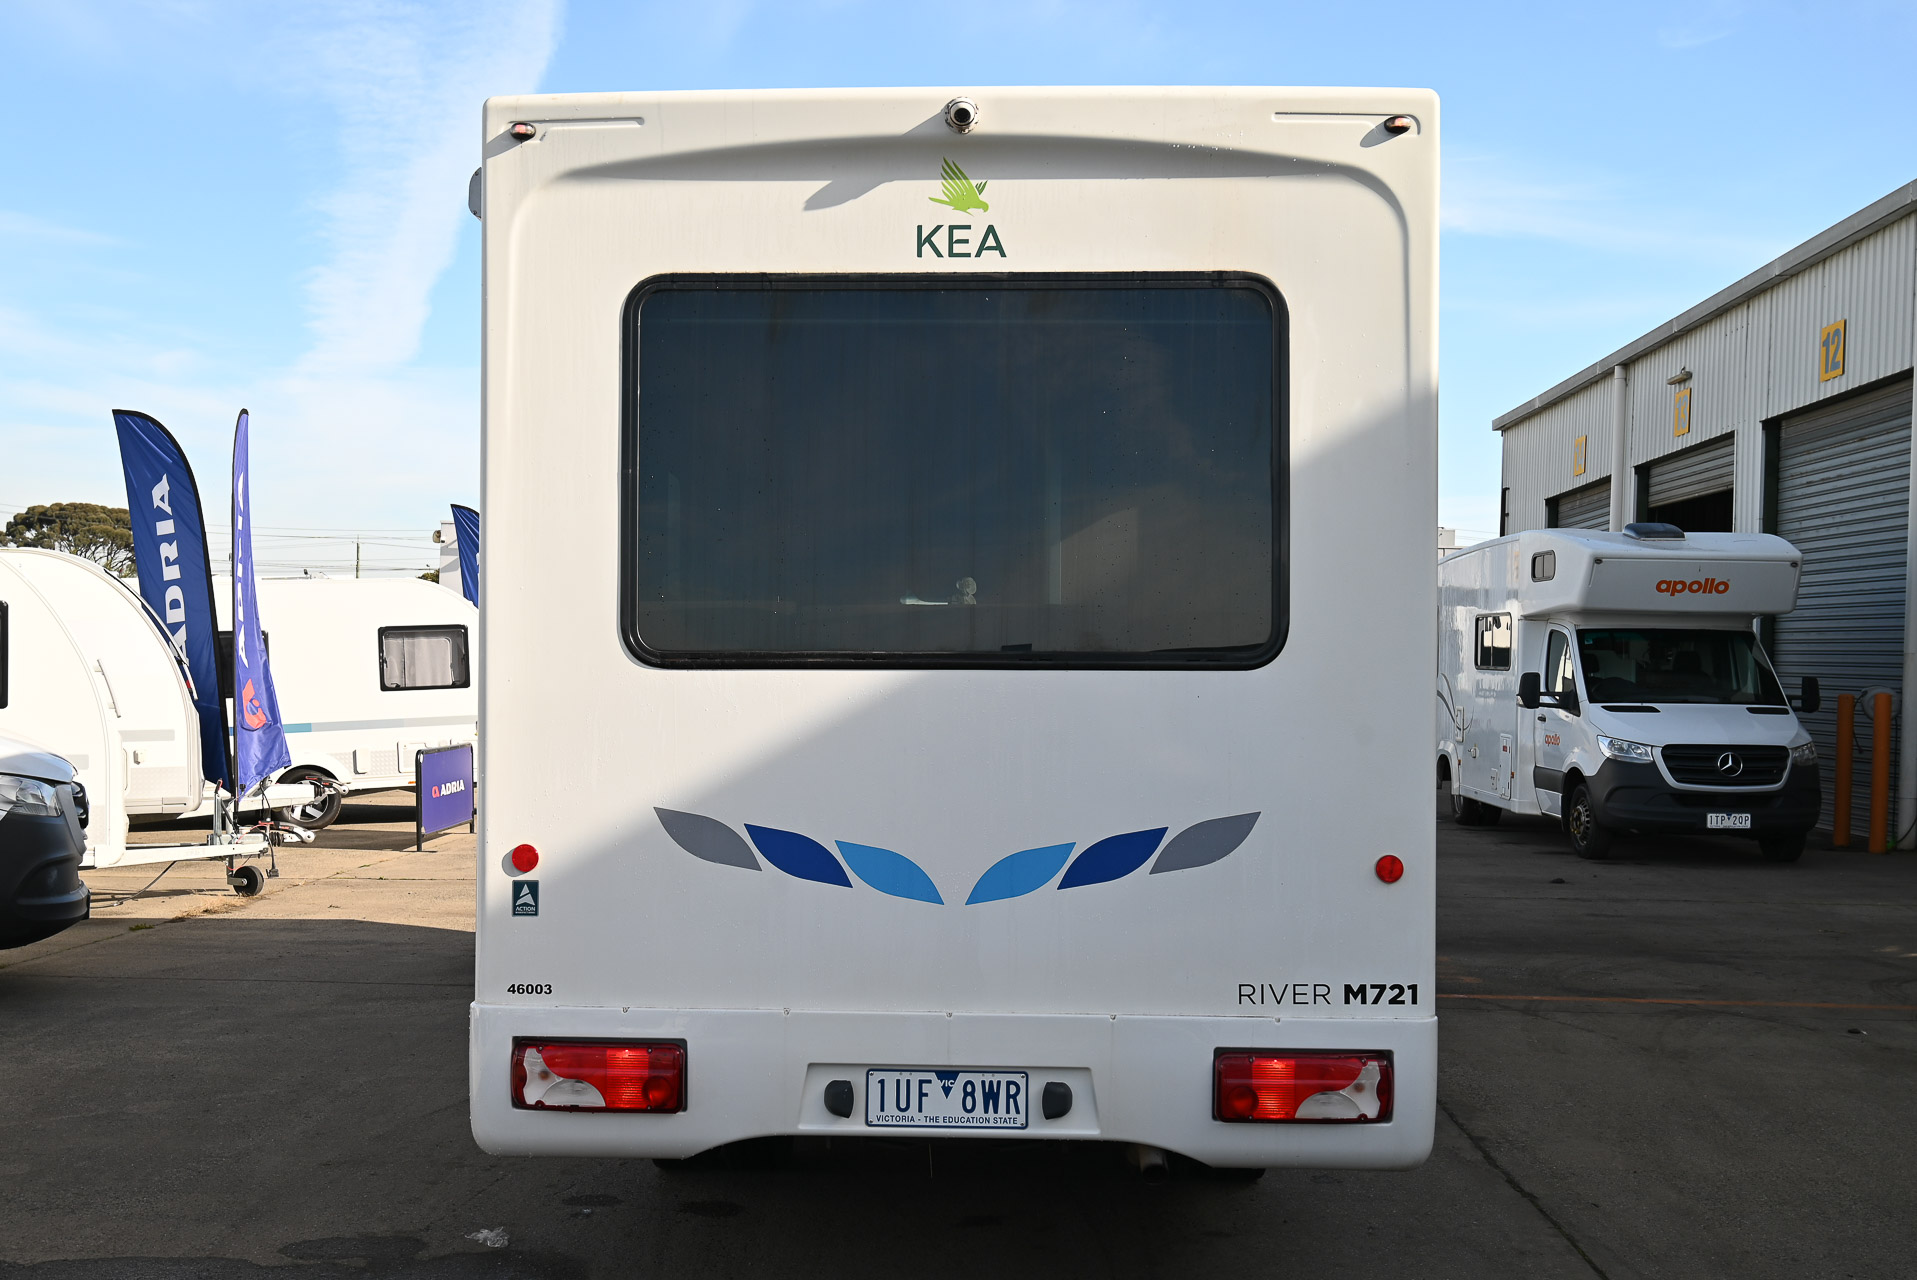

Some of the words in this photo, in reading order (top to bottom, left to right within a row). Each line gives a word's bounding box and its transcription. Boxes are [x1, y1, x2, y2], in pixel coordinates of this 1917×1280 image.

[917, 224, 1007, 258] KEA
[1822, 328, 1842, 374] 12
[1676, 394, 1688, 431] 13
[151, 473, 190, 667] ADRIA
[1655, 577, 1730, 597] apollo
[440, 779, 465, 797] ADRIA
[1709, 815, 1726, 825] 1TP
[507, 983, 553, 995] 46003
[1238, 983, 1331, 1005] RIVER
[1343, 983, 1418, 1005] M721
[877, 1078, 933, 1113] 1UF
[961, 1079, 1021, 1115] 8WR
[875, 1114, 916, 1123] VICTORIA
[923, 1115, 940, 1124] THE
[942, 1115, 991, 1125] EDUCATION
[992, 1116, 1018, 1125] STATE
